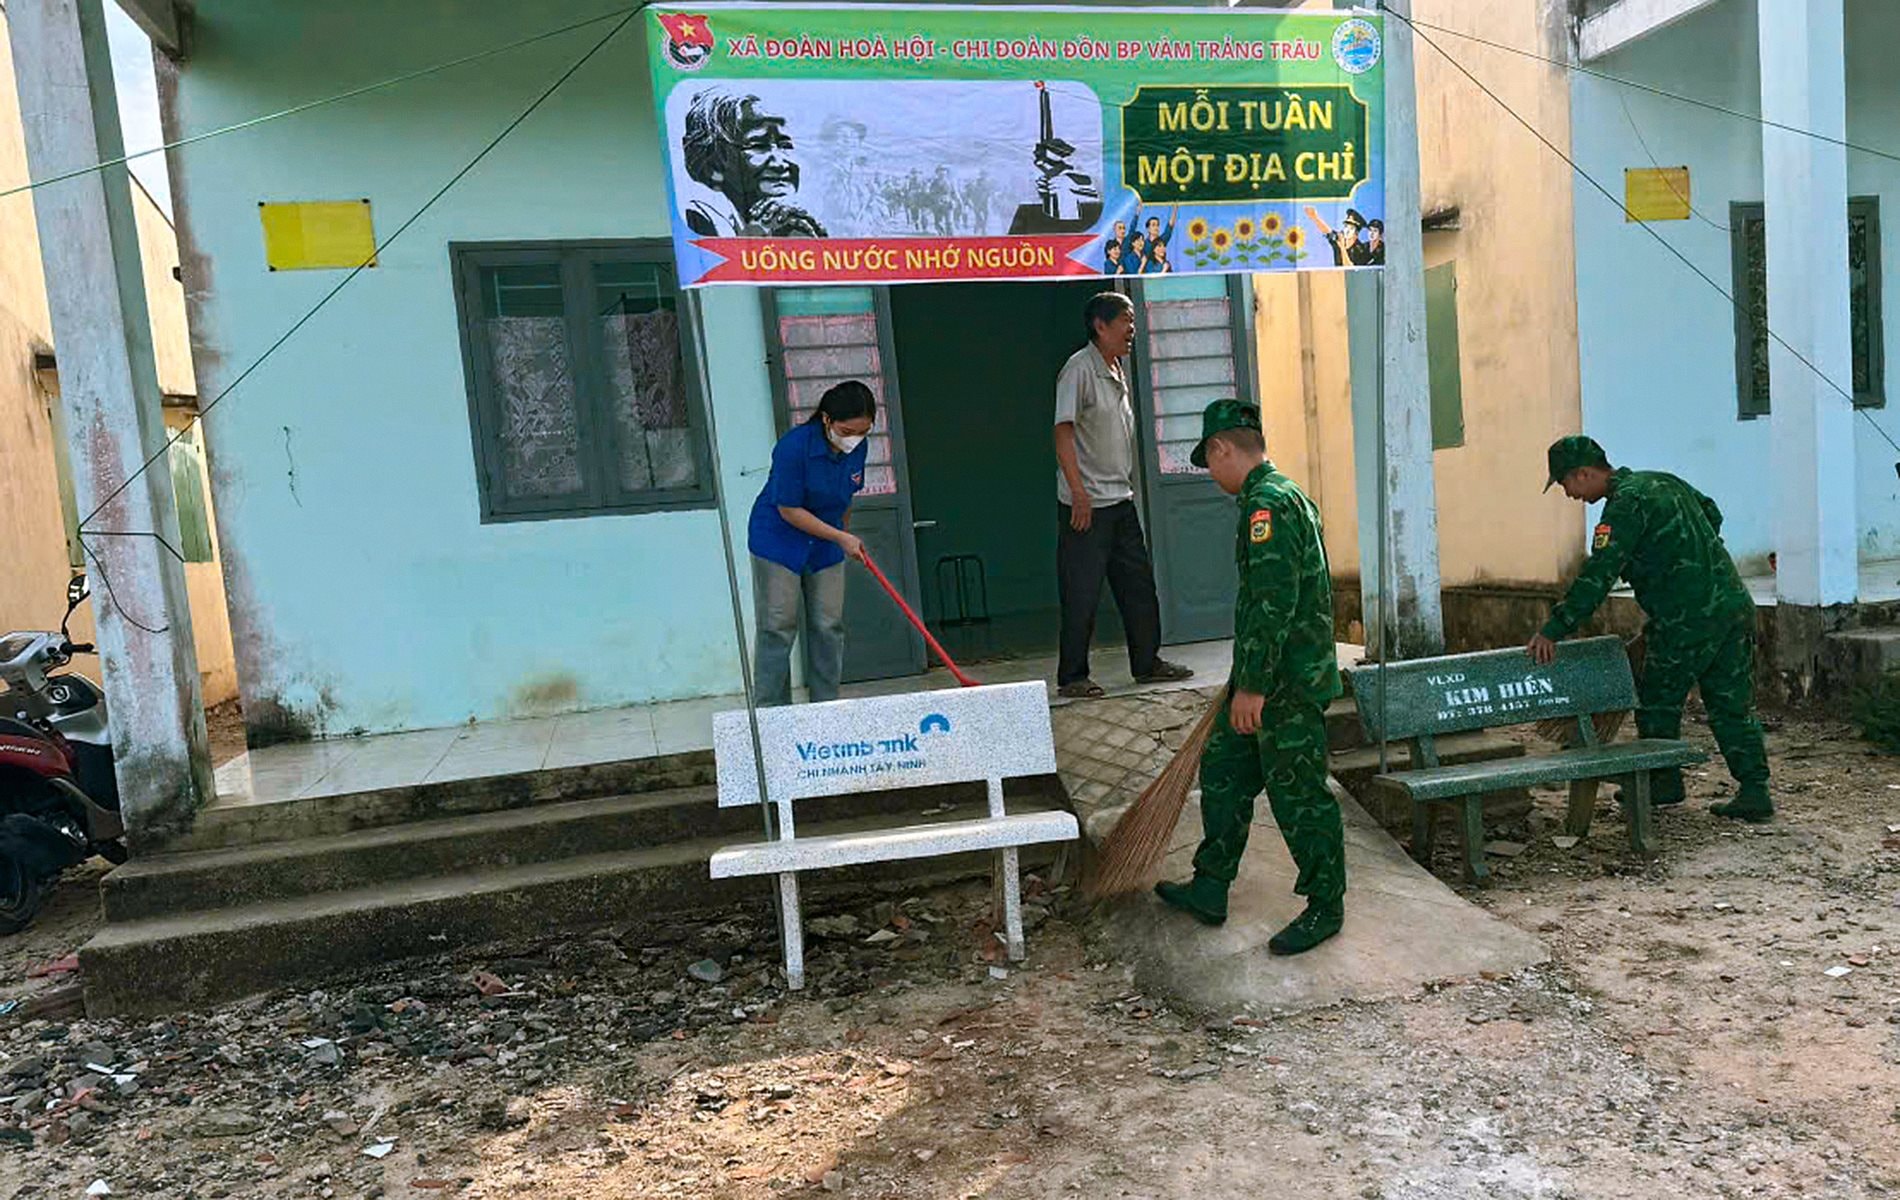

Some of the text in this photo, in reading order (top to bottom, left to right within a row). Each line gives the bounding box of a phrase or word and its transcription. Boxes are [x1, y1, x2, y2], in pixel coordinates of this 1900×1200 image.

[728, 35, 759, 57] XÃ
[766, 34, 831, 57] ĐOÀN
[839, 34, 887, 57] HOÀ
[893, 35, 933, 62] HỘI
[953, 40, 989, 58] CHI
[995, 36, 1057, 58] ĐOÀN
[1117, 41, 1142, 58] BP
[1270, 38, 1320, 59] TRÂU
[1157, 88, 1333, 131] MỖI TUẦN
[1137, 142, 1355, 192] MỘT ĐỊA CHỈ
[741, 240, 1055, 270] UỐNG NƯỚC NHỚ NGUỒN
[1426, 673, 1466, 686] VLXD
[1445, 687, 1490, 707] KIM
